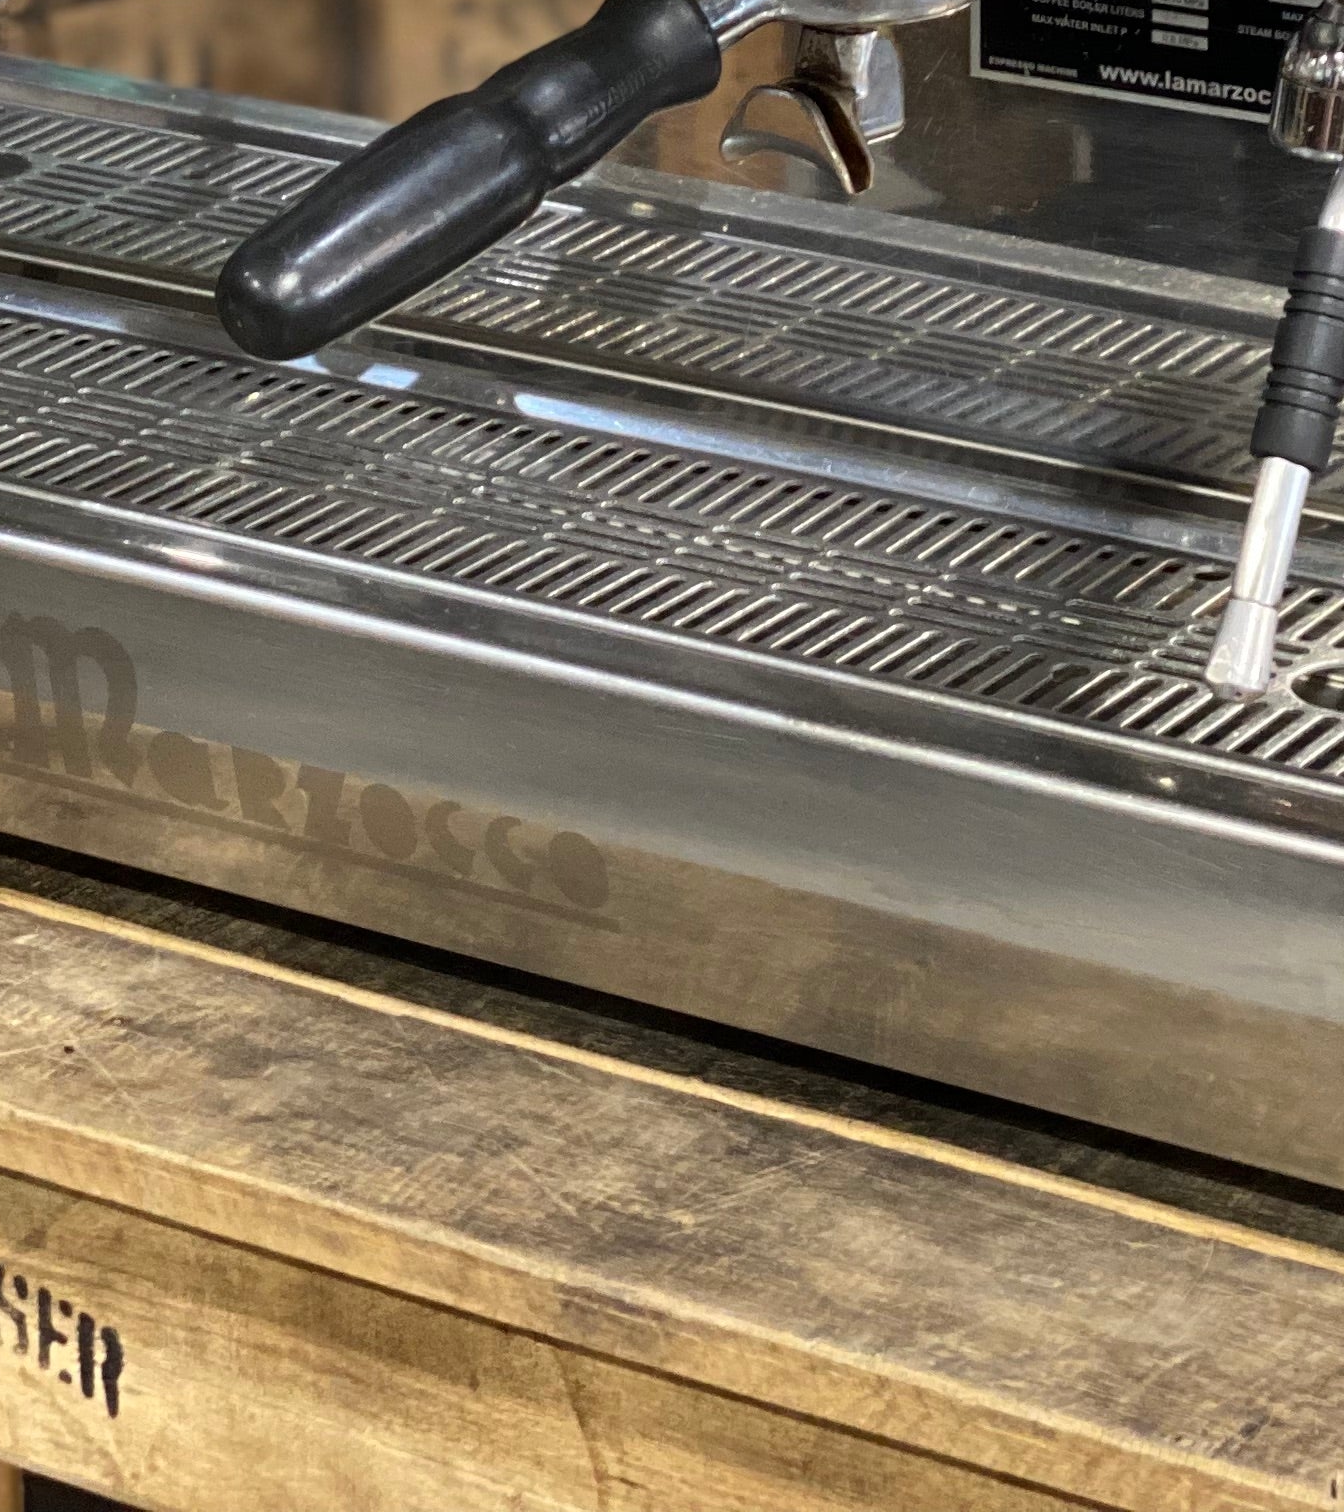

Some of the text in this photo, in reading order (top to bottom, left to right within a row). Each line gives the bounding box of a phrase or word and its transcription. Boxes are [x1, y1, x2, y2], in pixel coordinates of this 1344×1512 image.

[1031, 13, 1054, 25] MAX
[1056, 17, 1089, 31] WATER
[1090, 23, 1118, 35] INLET
[1237, 24, 1273, 38] STEAM
[1099, 64, 1272, 105] www.lamarzoc
